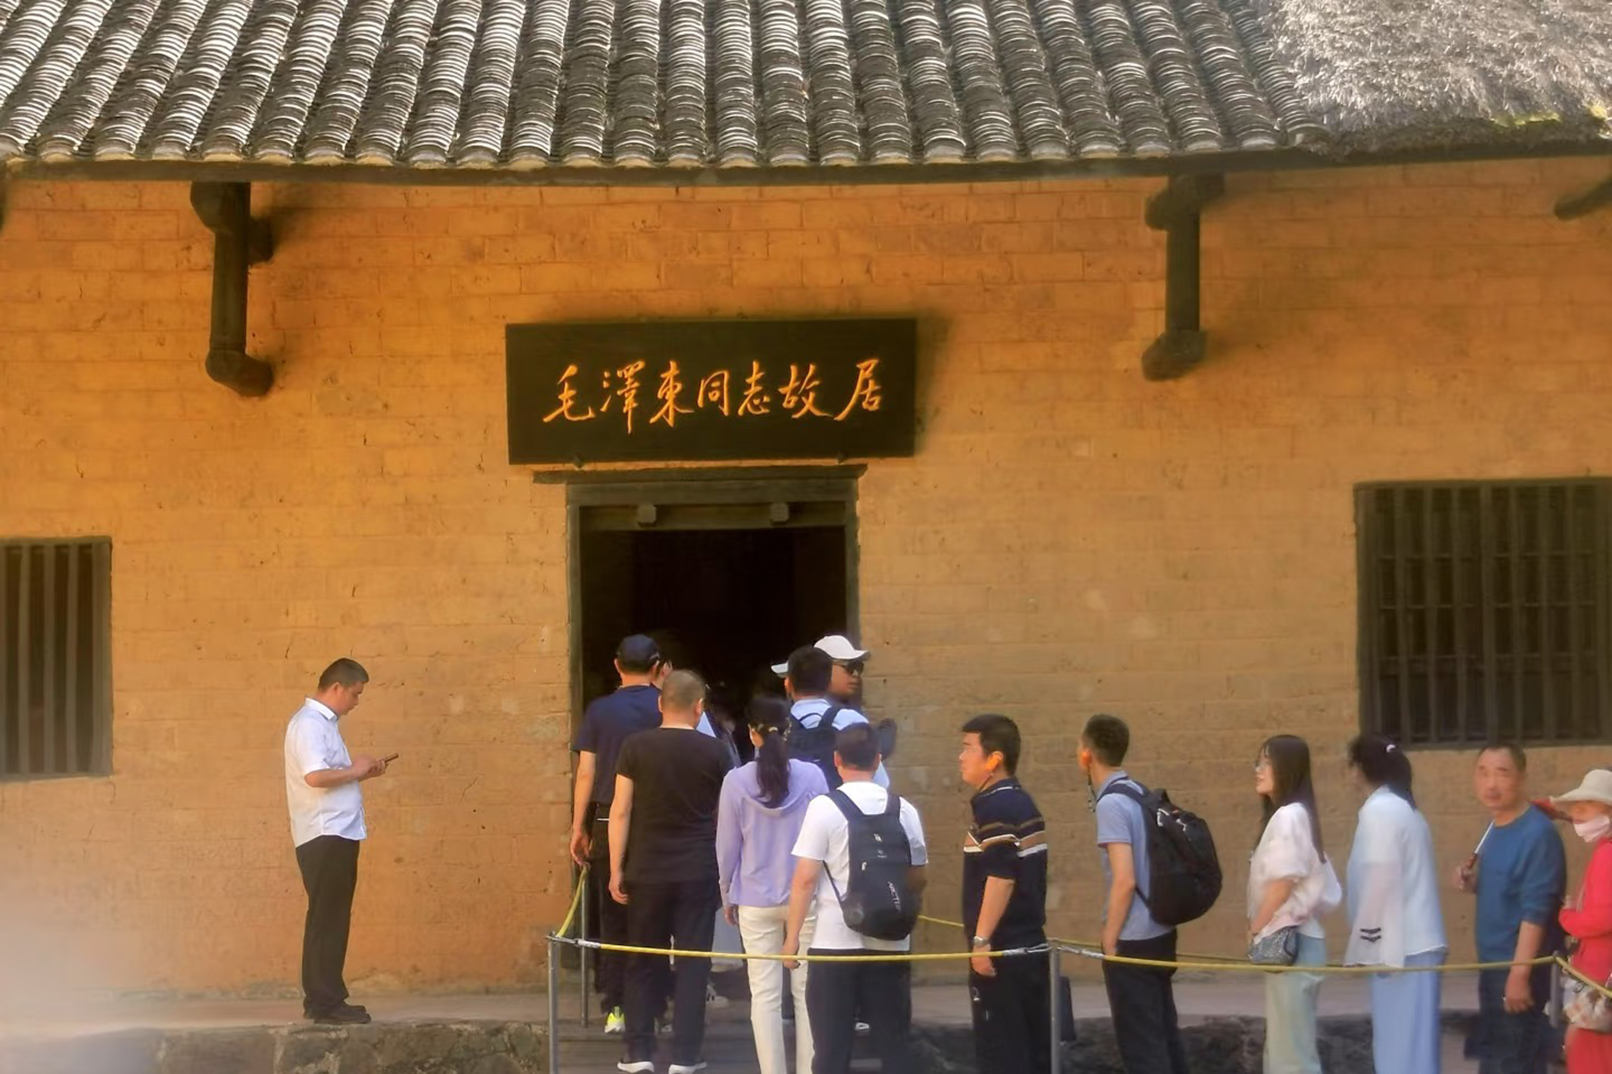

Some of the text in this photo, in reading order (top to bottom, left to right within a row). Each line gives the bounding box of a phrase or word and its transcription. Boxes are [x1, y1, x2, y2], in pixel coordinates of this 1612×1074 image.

[542, 358, 882, 434] 毛澤東同志故居
